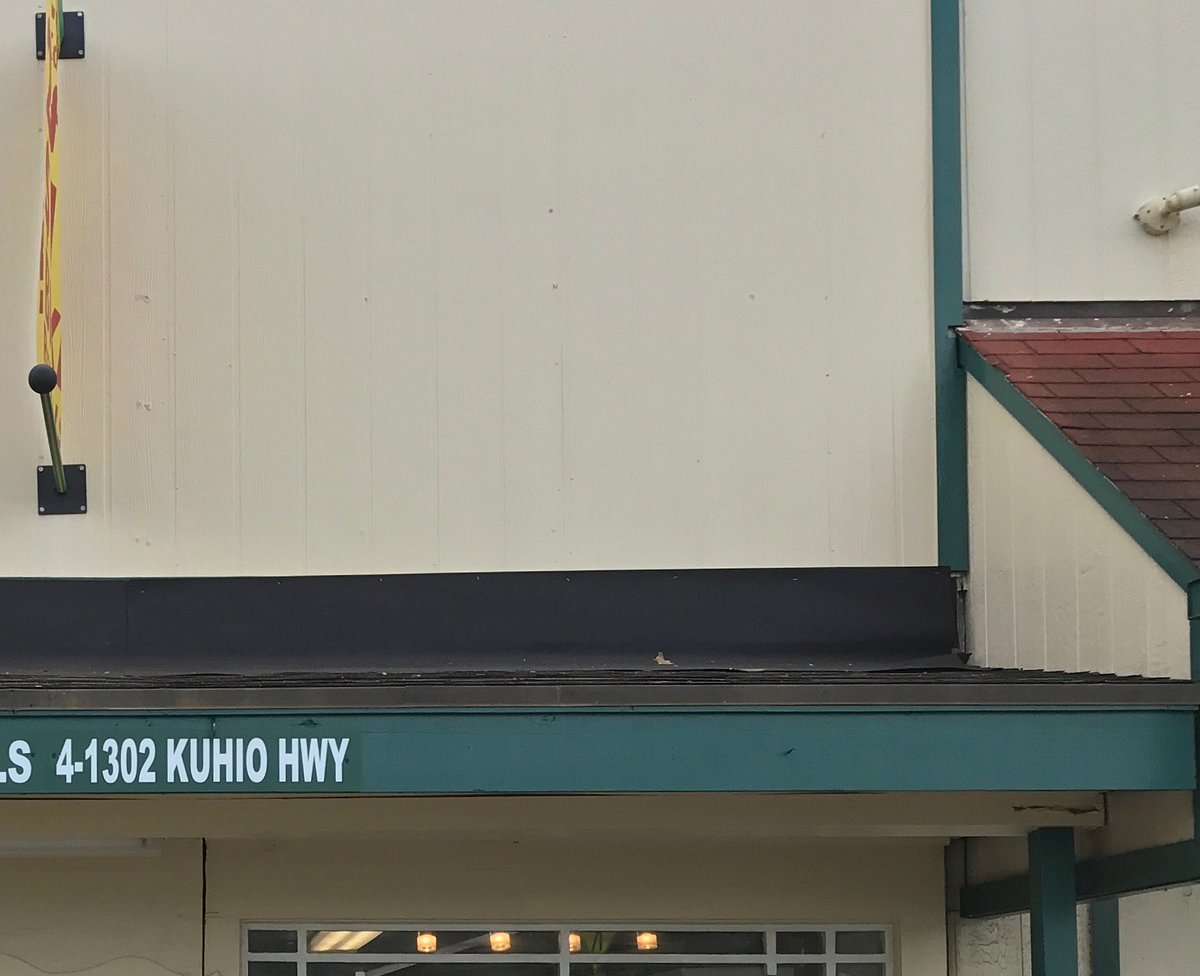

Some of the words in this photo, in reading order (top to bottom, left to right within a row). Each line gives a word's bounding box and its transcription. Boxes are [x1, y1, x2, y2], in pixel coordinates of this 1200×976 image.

[55, 738, 156, 783] 4-1302
[167, 738, 268, 783] KUHIO
[279, 738, 350, 782] HWY
